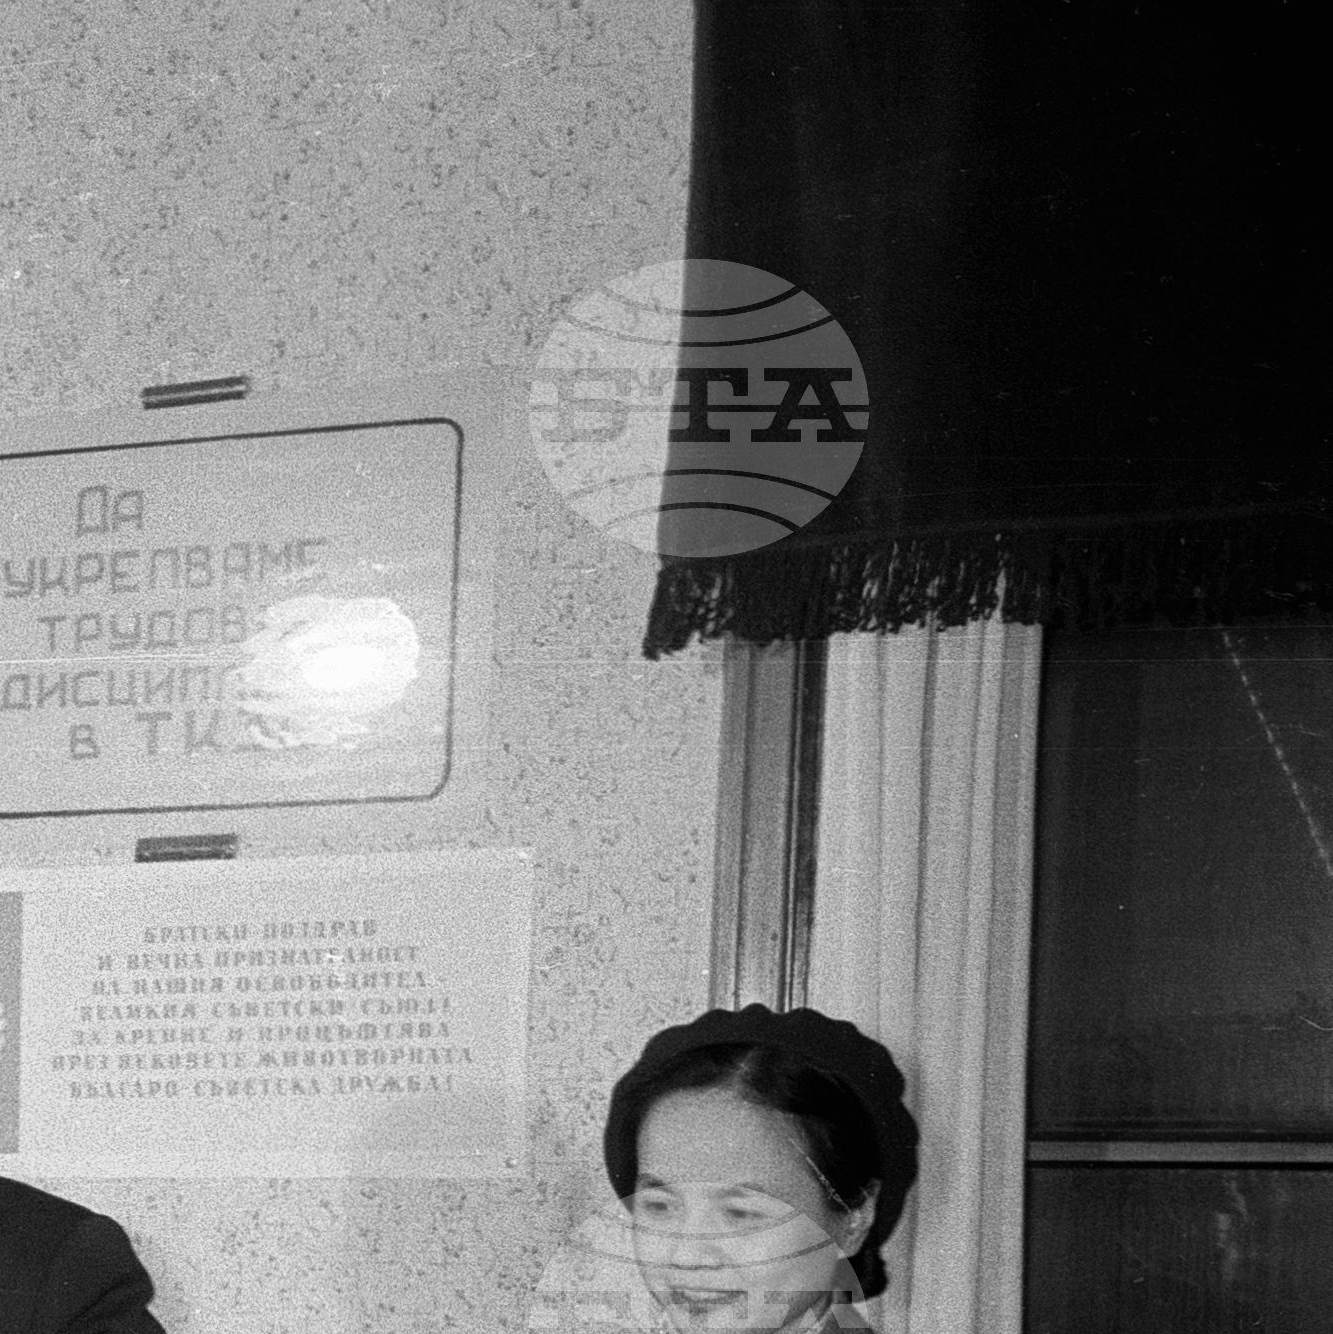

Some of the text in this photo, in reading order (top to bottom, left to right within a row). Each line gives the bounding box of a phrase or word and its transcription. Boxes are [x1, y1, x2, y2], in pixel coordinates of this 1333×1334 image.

[75, 484, 145, 536] ДА
[69, 725, 100, 760] В
[142, 919, 378, 943] БРАТСКИ ПОЗДРАВ
[127, 952, 203, 970] ВЕЧНА
[214, 946, 420, 966] ПРИЗНАТЕЛНОСТ
[92, 979, 121, 995] НА
[134, 977, 223, 995] НАШИЯ
[51, 1054, 108, 1071] ПРЕЗ
